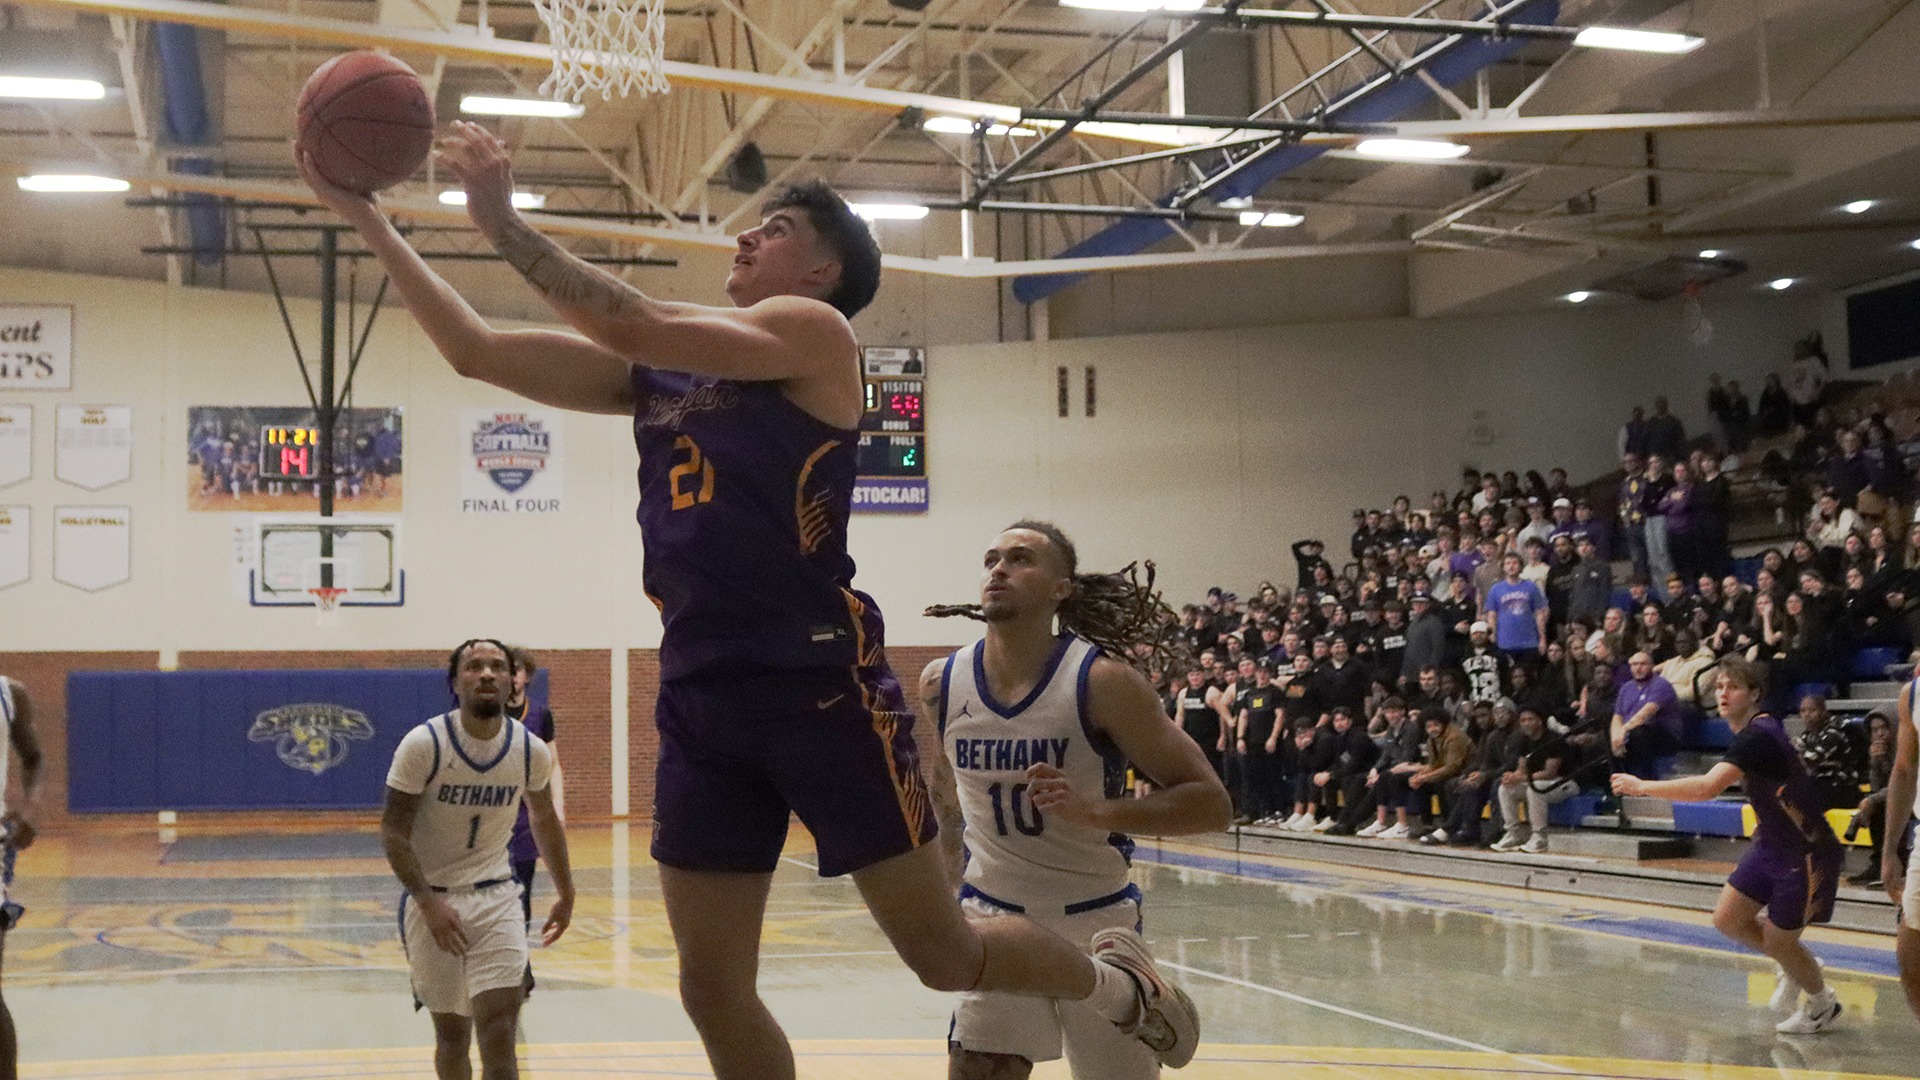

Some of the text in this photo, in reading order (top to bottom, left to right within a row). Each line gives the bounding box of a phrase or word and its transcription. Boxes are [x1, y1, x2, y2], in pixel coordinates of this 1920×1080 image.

[882, 382, 922, 393] VISITOR
[473, 433, 549, 453] SOFTBALL
[890, 436, 916, 446] FOULS
[280, 447, 308, 476] 14
[462, 499, 560, 512] FINAL FOUR
[852, 487, 926, 504] STOCKAR!
[956, 738, 1070, 771] BETHANY
[437, 784, 518, 807] BETHANY
[988, 782, 1045, 837] 10
[467, 814, 480, 849] 1
